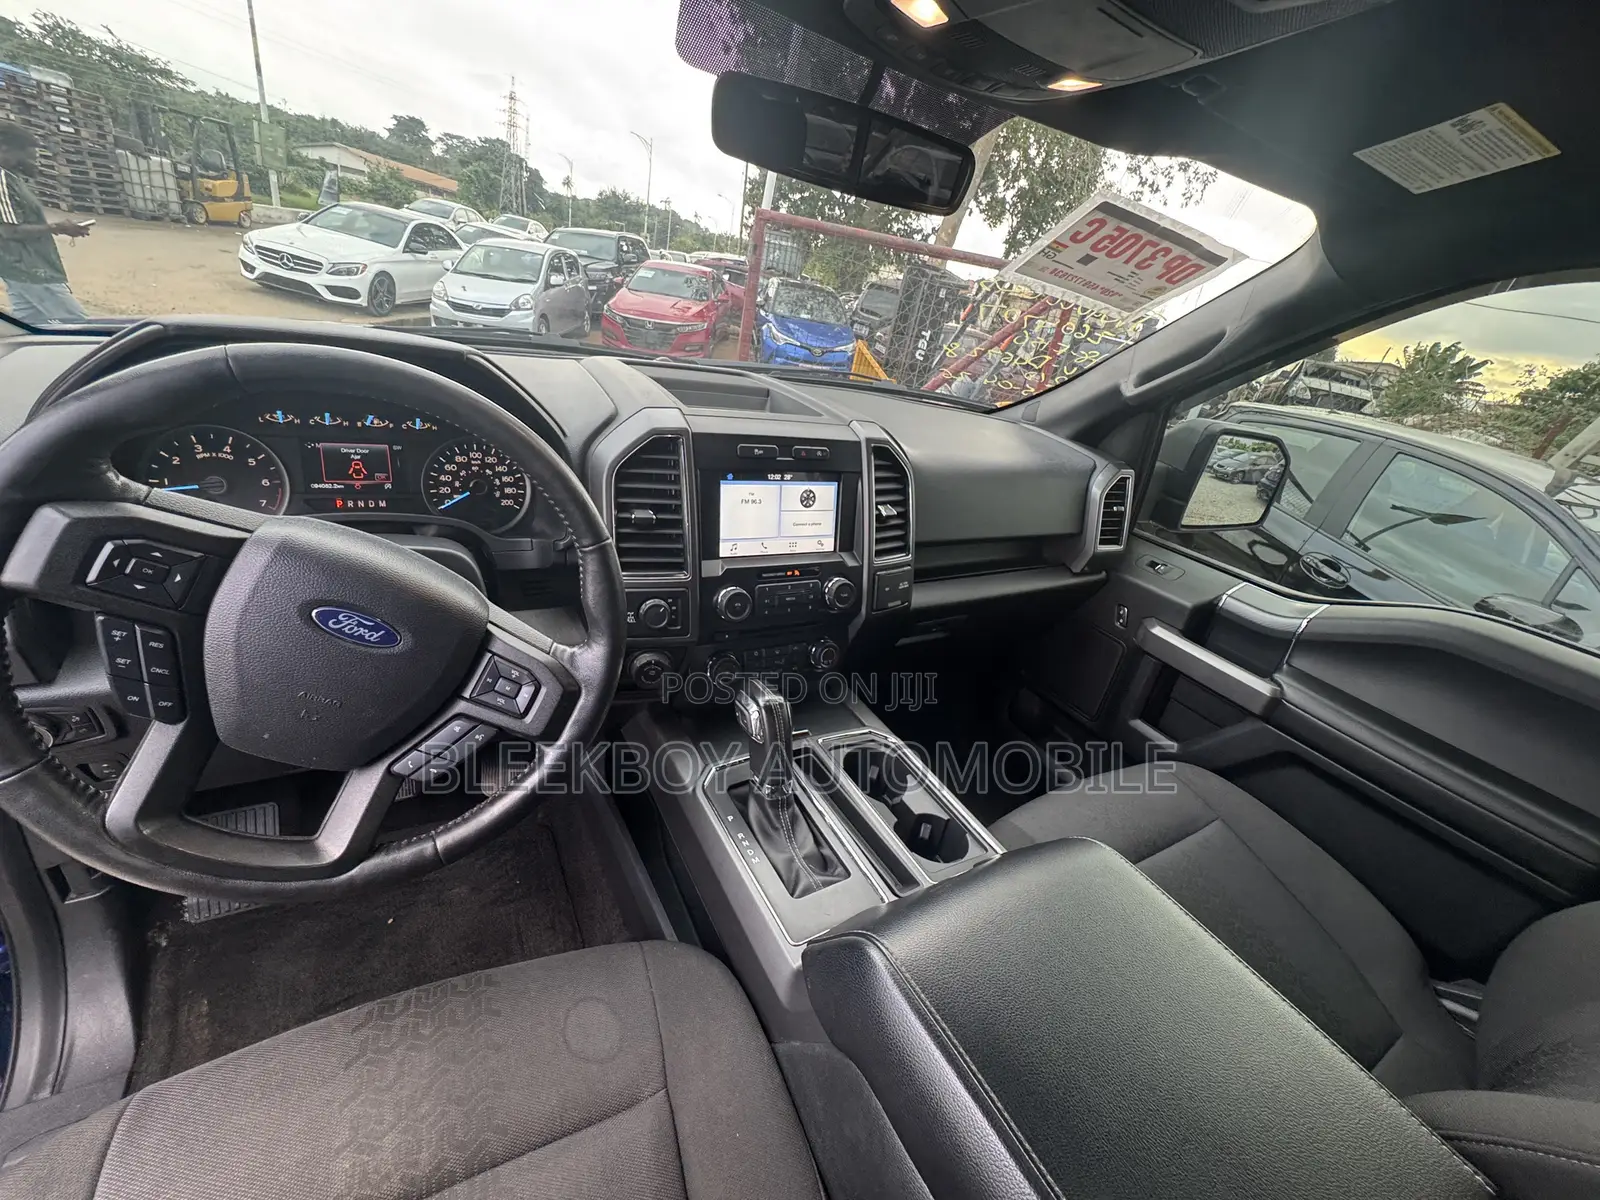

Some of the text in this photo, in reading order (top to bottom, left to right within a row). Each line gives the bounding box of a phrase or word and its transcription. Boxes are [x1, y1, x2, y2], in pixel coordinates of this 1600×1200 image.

[194, 444, 203, 453] 3
[223, 445, 232, 453] 4
[172, 456, 181, 465] 2
[247, 458, 256, 466] 5
[261, 479, 270, 487] 6
[336, 500, 343, 508] P
[328, 612, 386, 642] Ford
[111, 629, 128, 637] SET
[148, 641, 164, 649] RES
[115, 657, 131, 665] SET
[150, 667, 170, 675] CNCL
